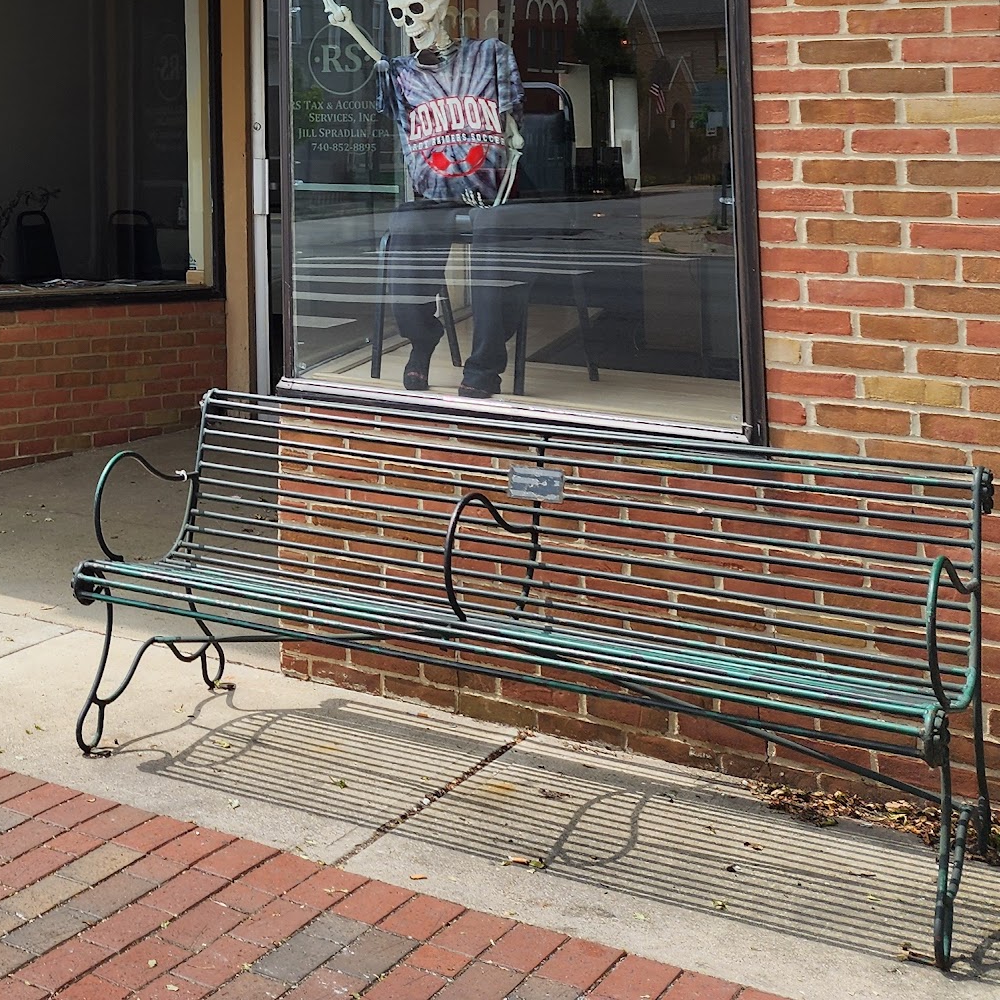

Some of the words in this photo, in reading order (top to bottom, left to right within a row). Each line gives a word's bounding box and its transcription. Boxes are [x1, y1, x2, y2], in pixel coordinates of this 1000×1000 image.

[320, 43, 363, 73] RS
[303, 100, 324, 111] TAX
[326, 101, 333, 110] &
[335, 100, 376, 111] ACCOUN
[409, 96, 502, 140] LONDON
[298, 127, 317, 139] JILL
[372, 129, 390, 138] CPA
[311, 142, 377, 152] 740-852-8895
